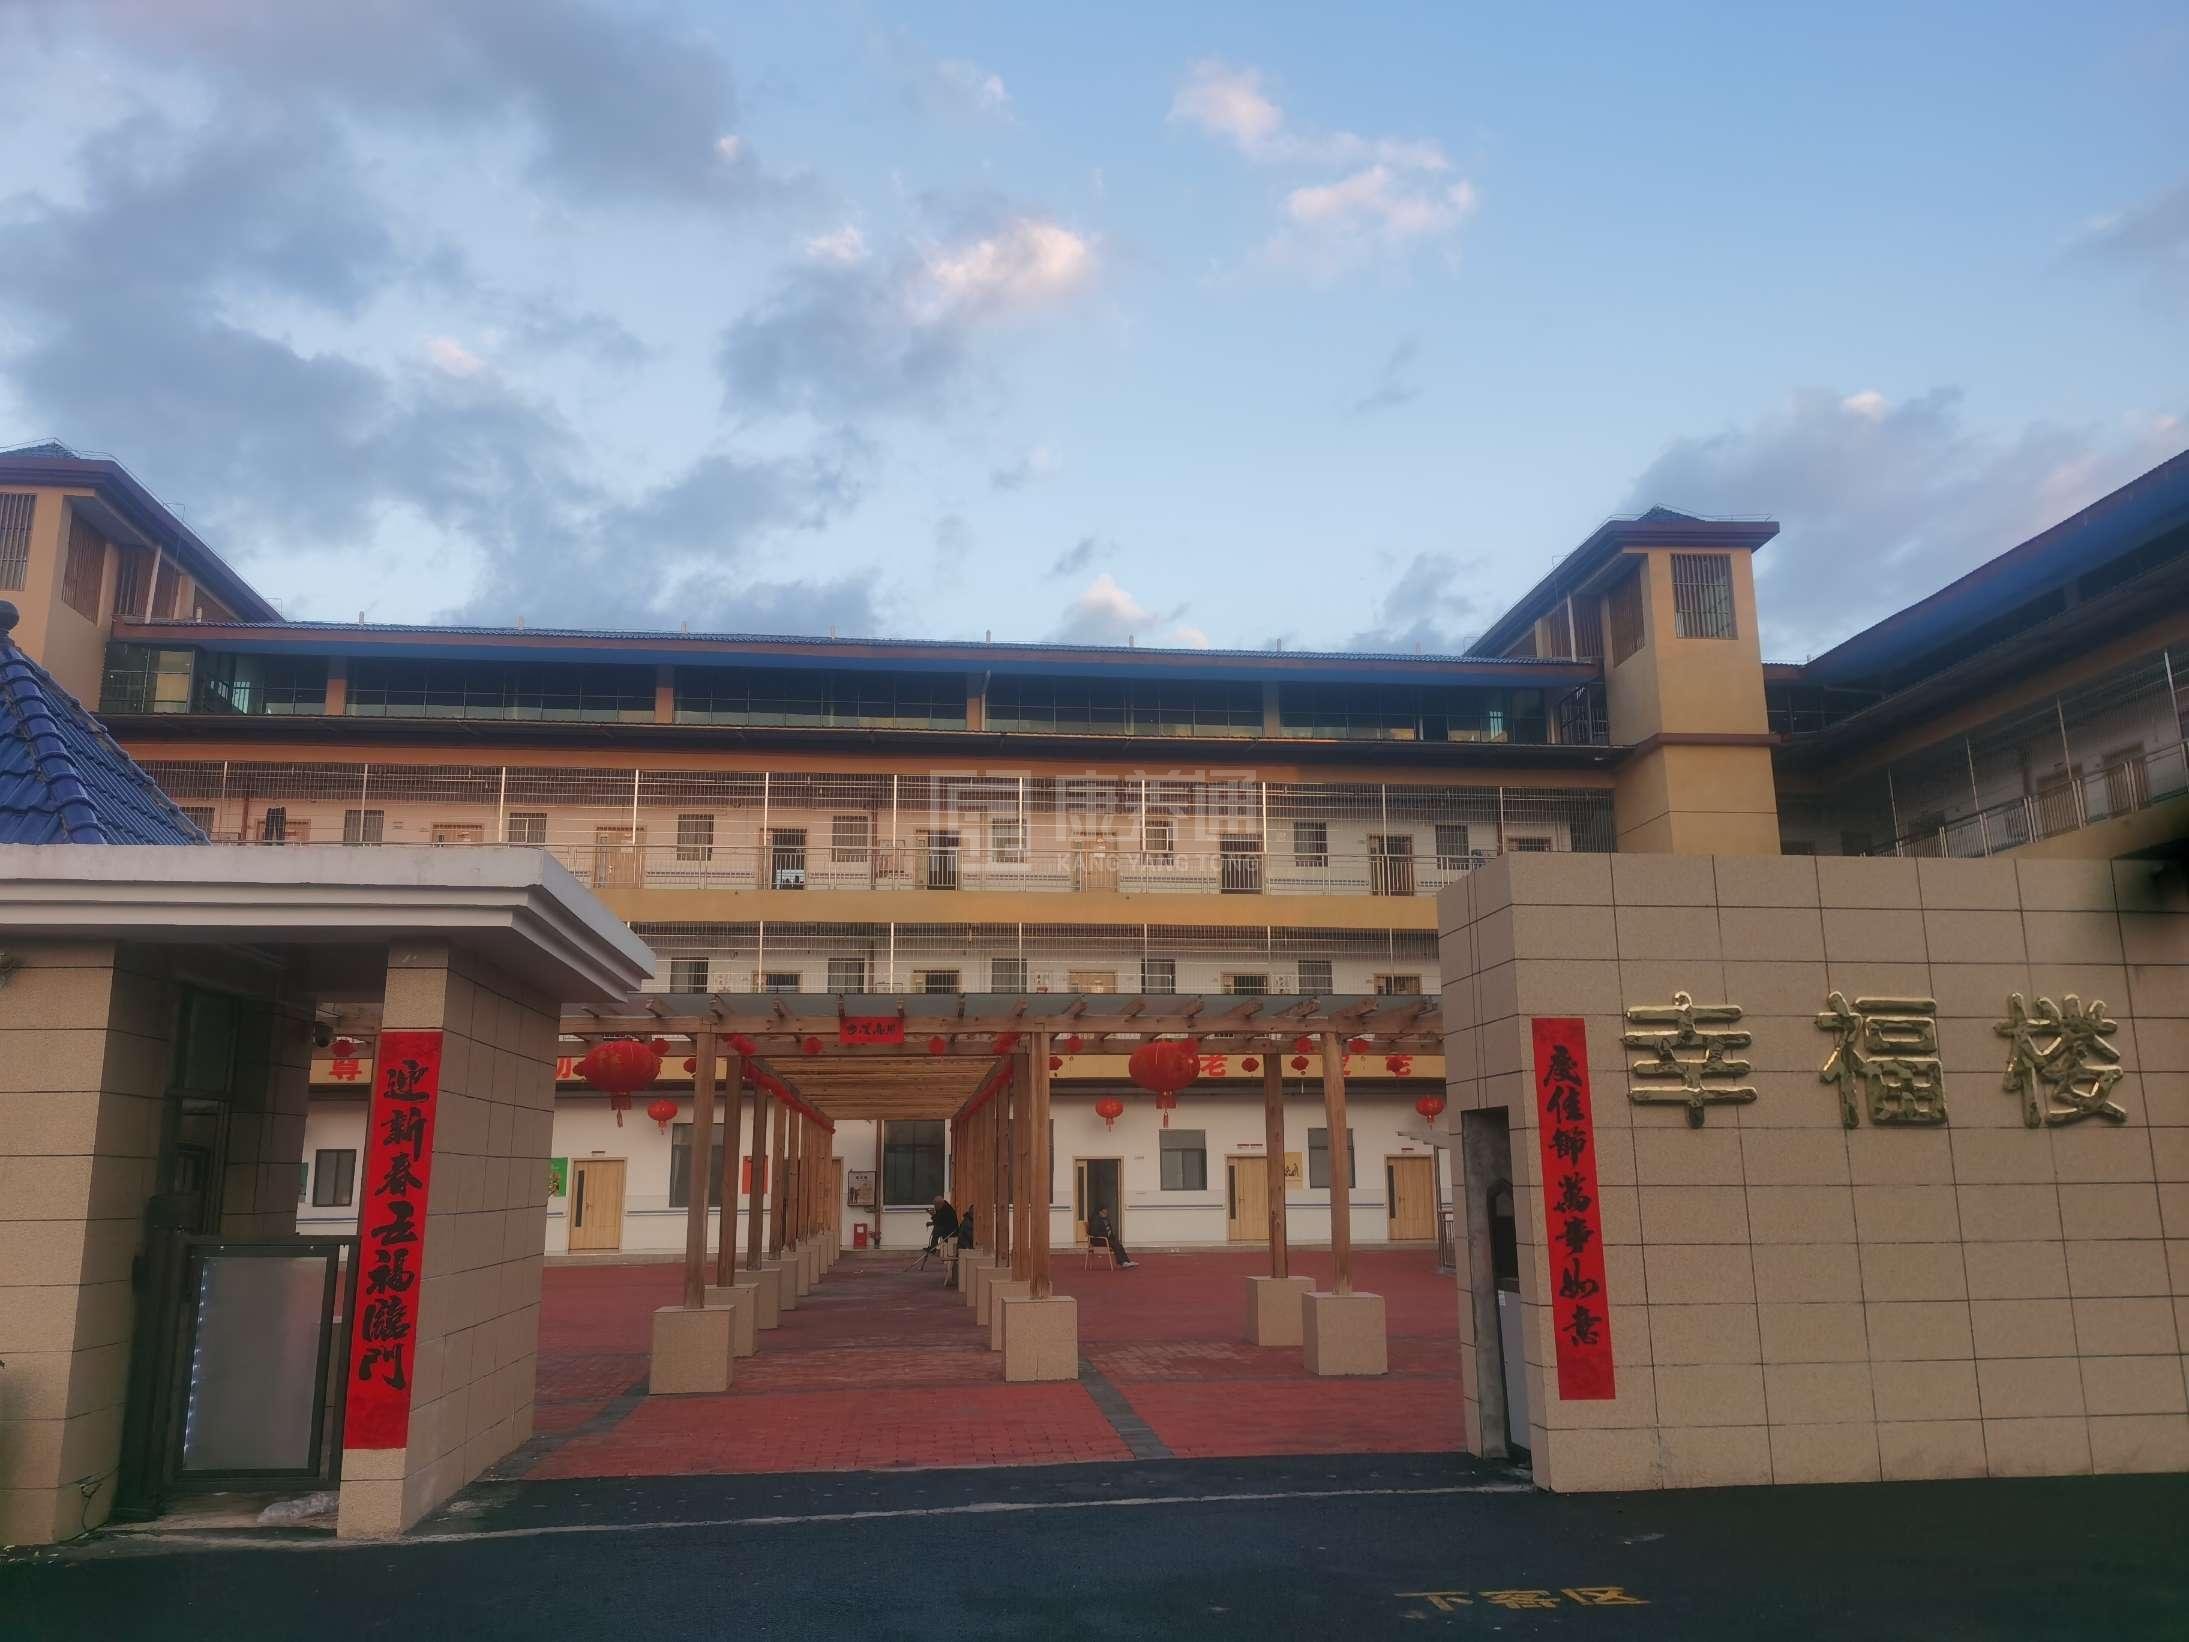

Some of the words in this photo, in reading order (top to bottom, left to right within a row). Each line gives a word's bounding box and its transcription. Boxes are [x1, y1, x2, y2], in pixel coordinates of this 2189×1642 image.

[1619, 990, 2128, 1129] 幸福楼
[1394, 1586, 1651, 1612] 下客区
